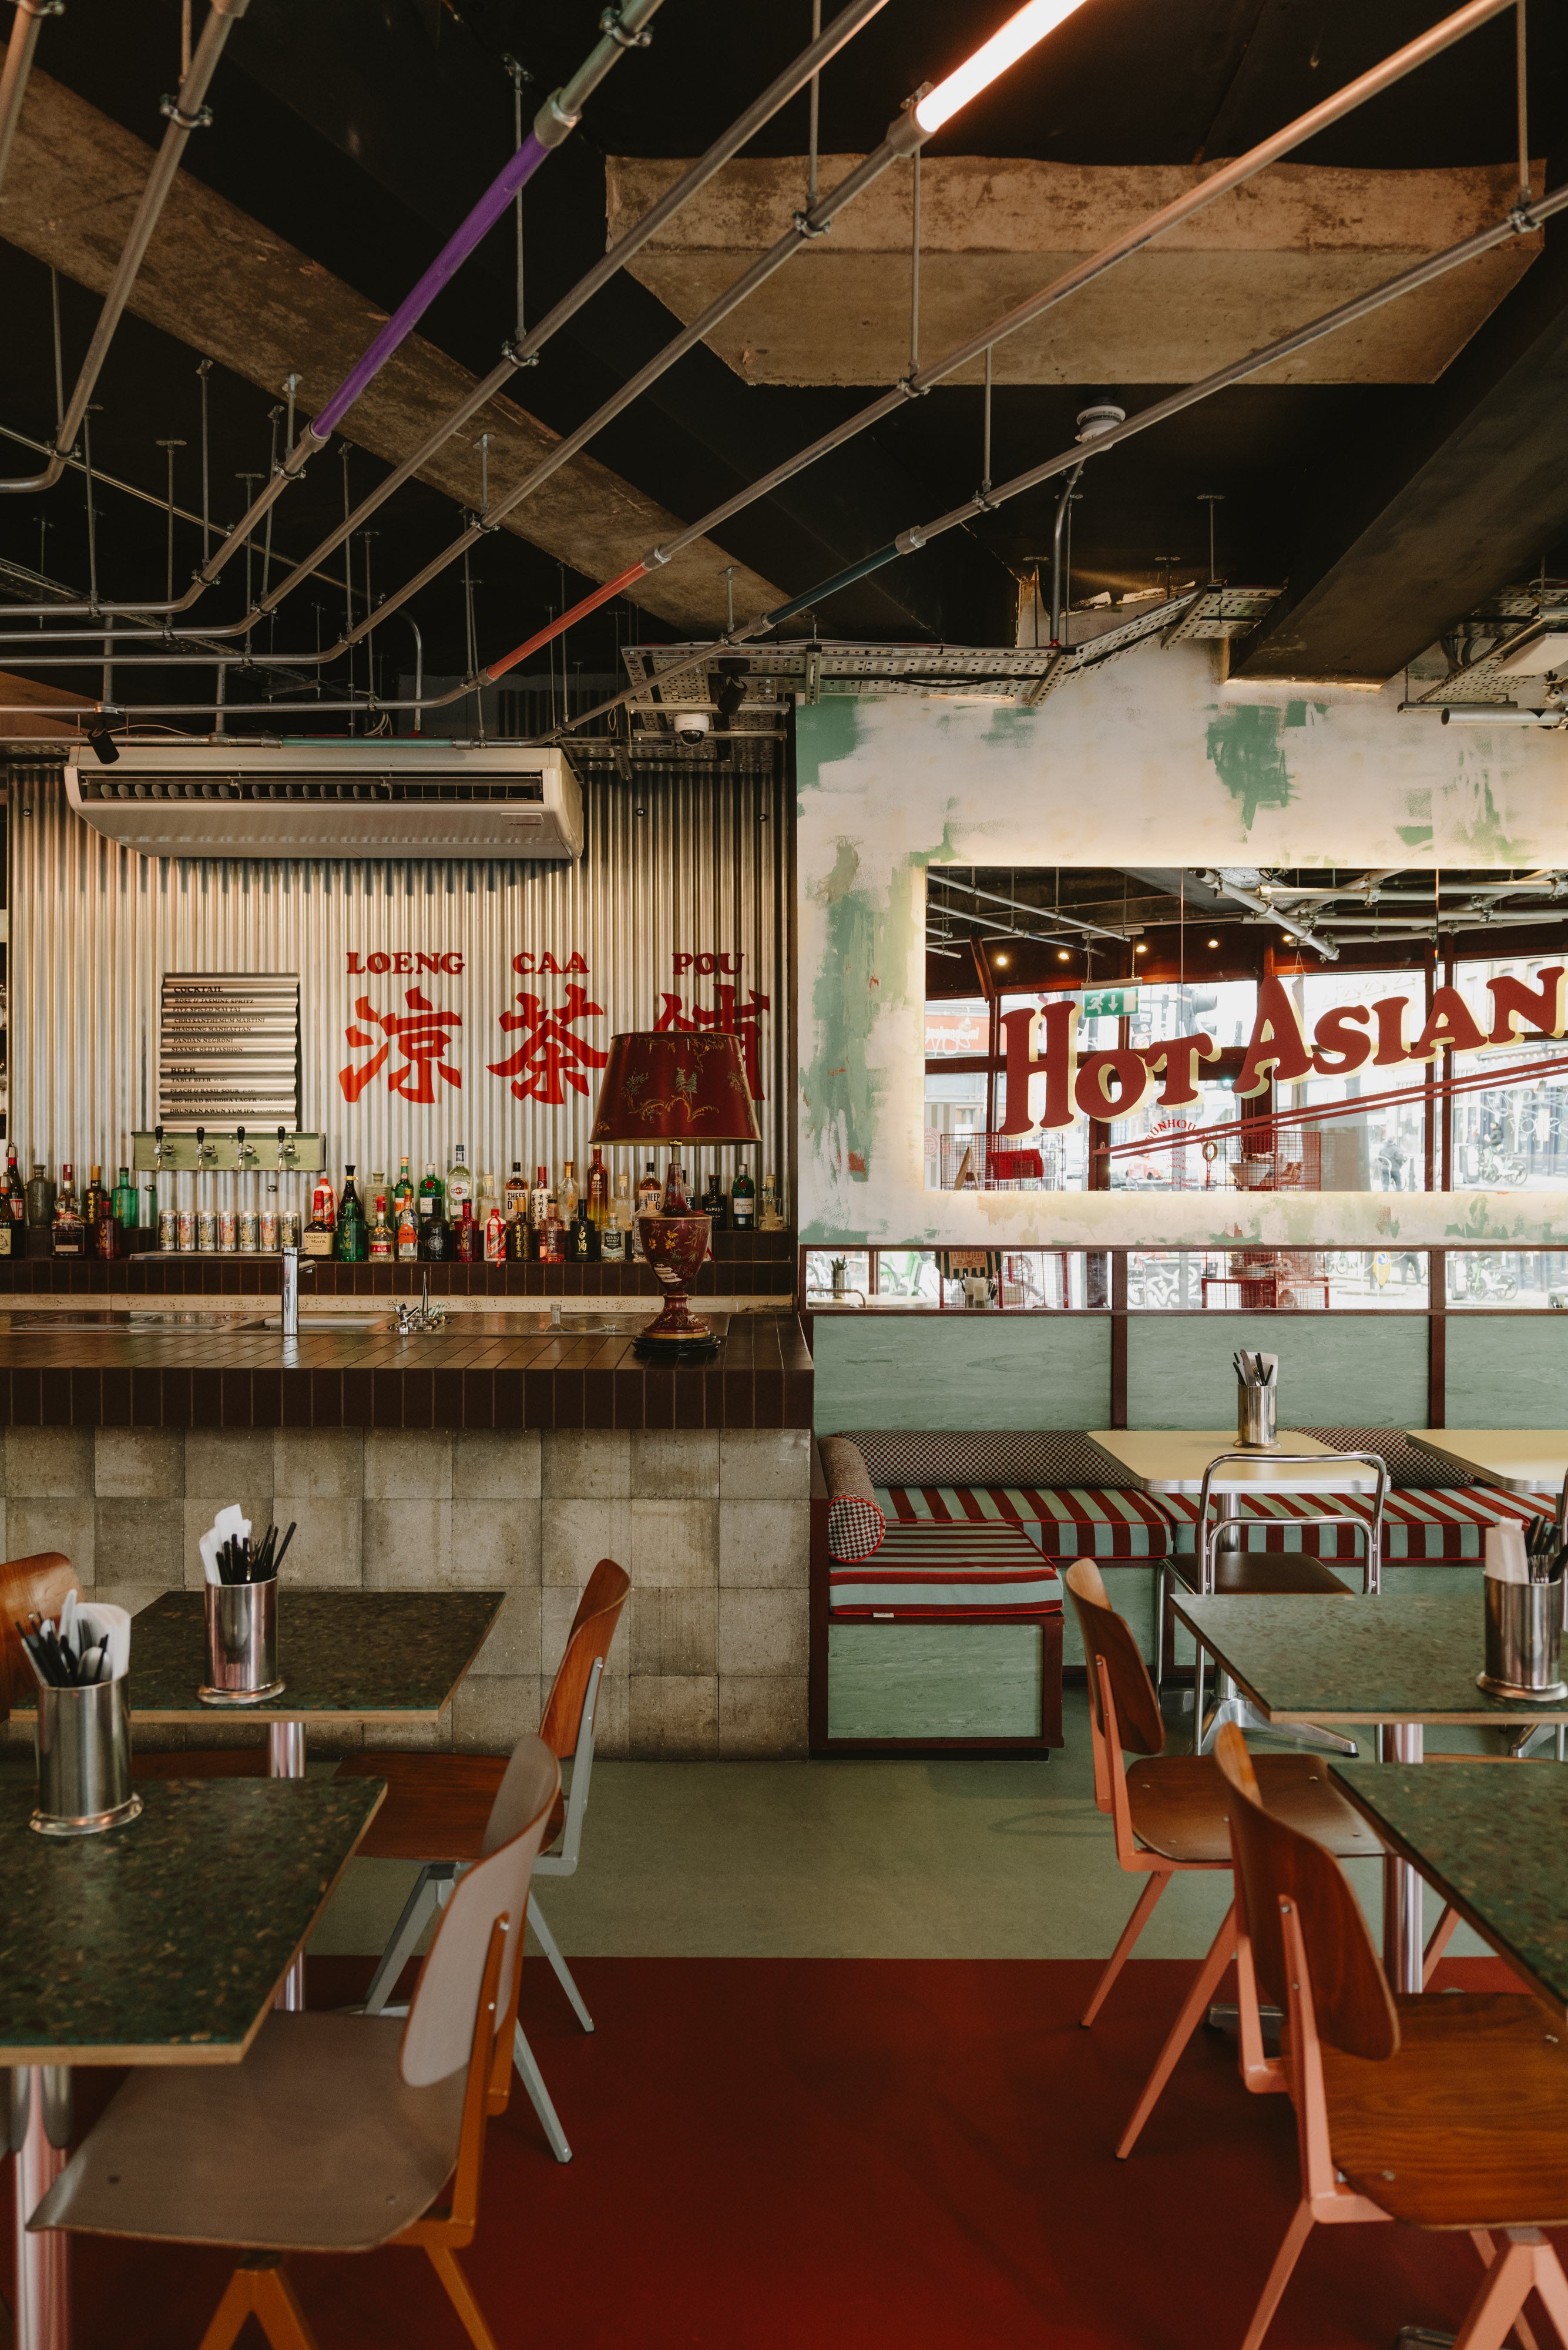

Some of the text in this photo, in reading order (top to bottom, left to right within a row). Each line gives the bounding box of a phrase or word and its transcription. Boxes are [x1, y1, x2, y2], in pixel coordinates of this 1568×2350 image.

[346, 951, 744, 975] LOENG CAA POU
[1232, 966, 1568, 1099] ASIAN
[99, 1223, 108, 1249] 白酒
[343, 1224, 351, 1250] 白酒
[461, 1225, 469, 1250] 白酒
[578, 1226, 587, 1252] 白酒
